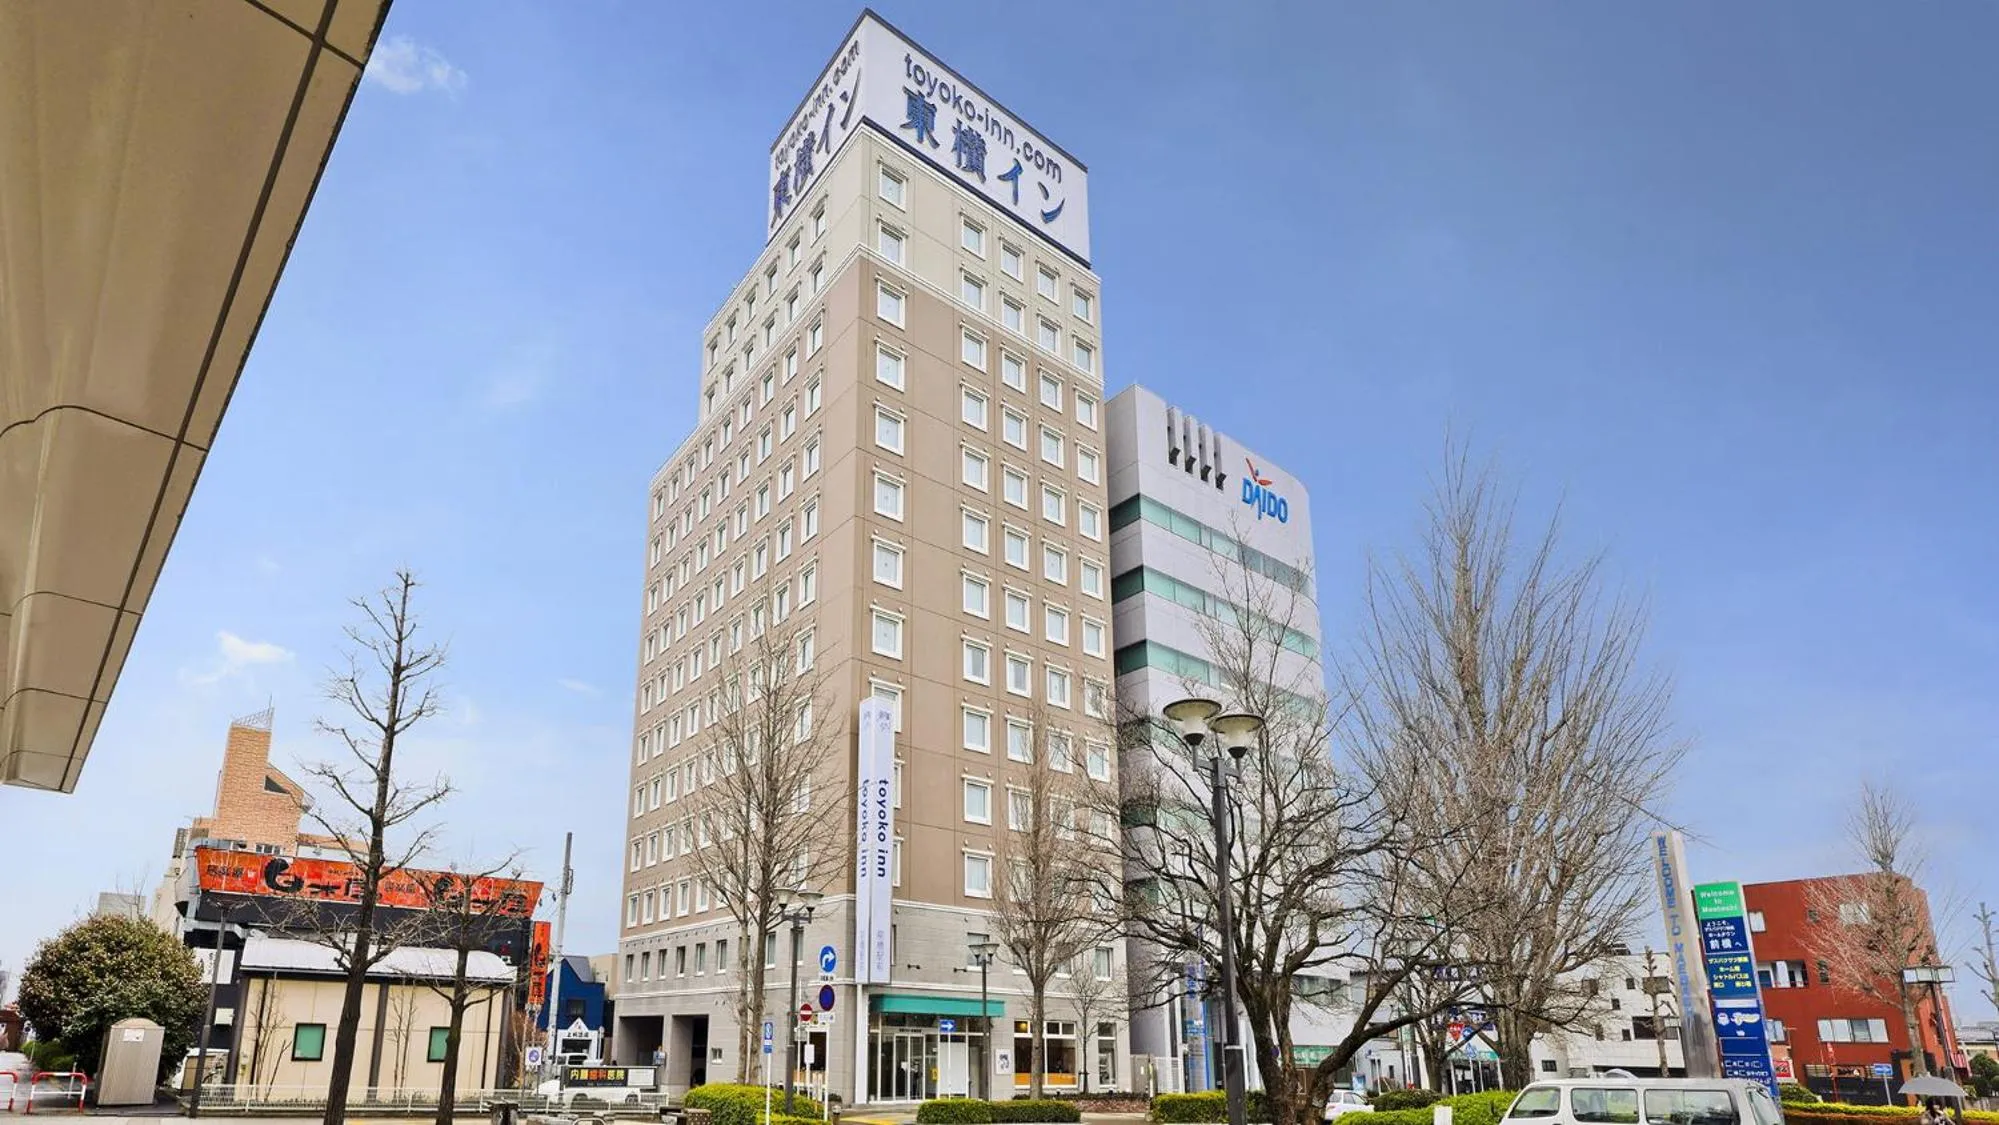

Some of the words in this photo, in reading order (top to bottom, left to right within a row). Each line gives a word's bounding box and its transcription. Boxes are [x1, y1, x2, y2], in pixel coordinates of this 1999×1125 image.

[770, 66, 861, 229] 東横イン
[904, 52, 1062, 184] toyoko-inn.com
[900, 86, 1066, 224] 東横イン
[1242, 477, 1288, 524] DAIDO
[861, 778, 870, 842] toyoko
[876, 778, 889, 842] toyoko
[860, 849, 869, 877] inn
[877, 848, 889, 877] inn
